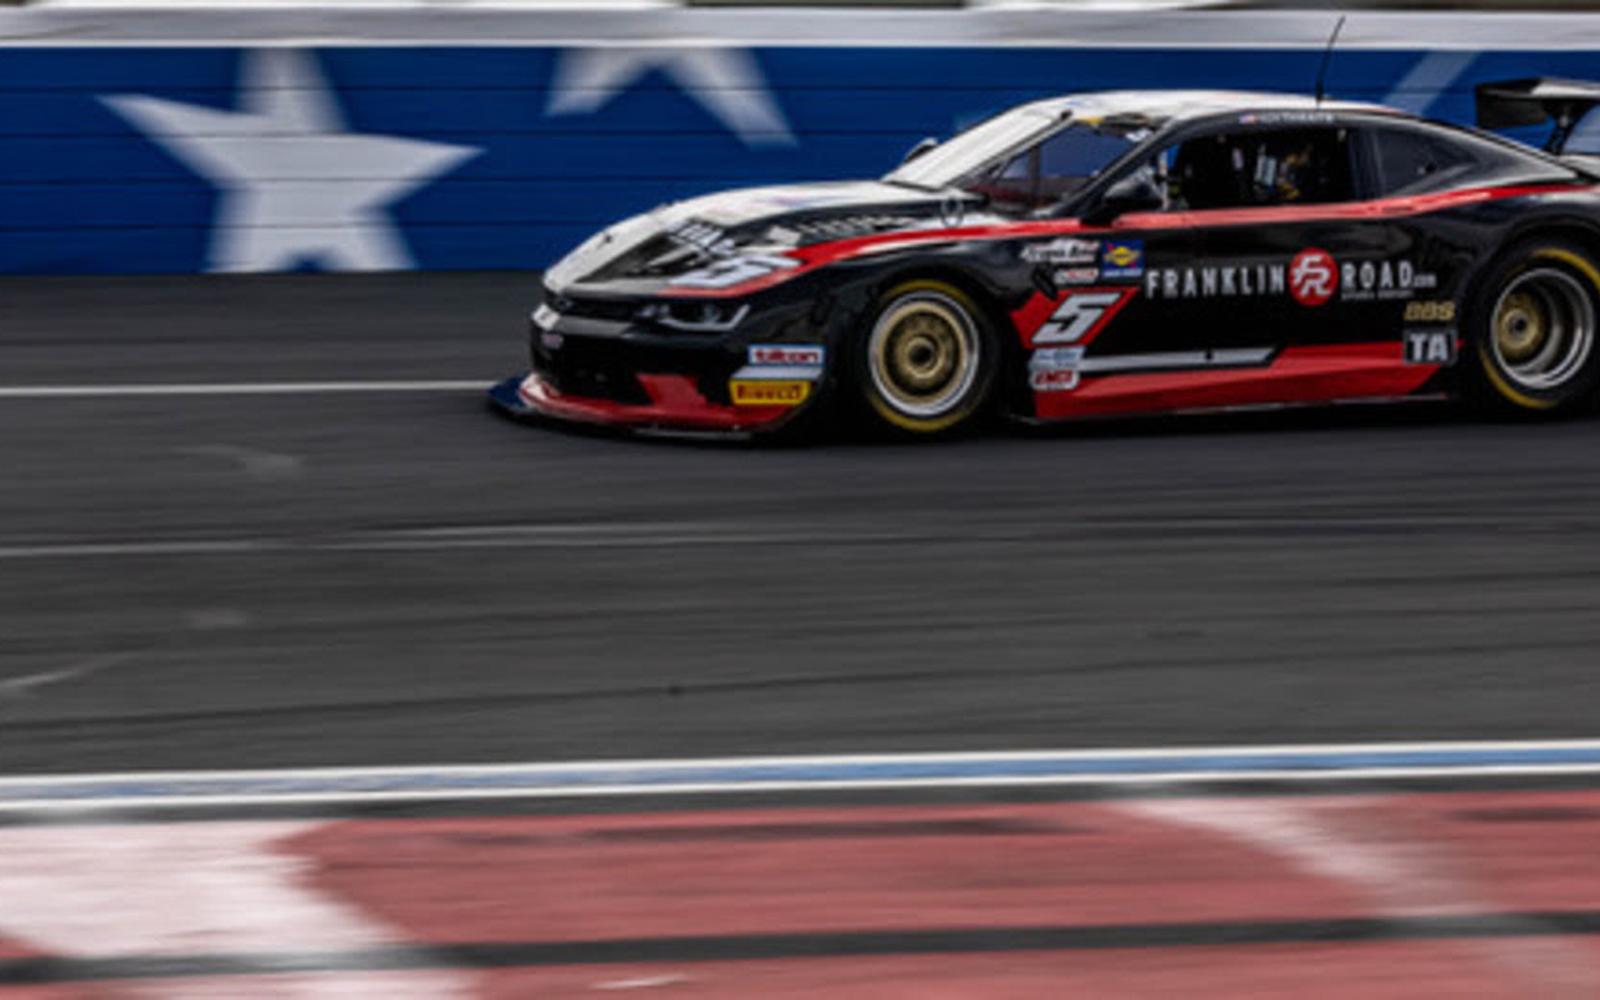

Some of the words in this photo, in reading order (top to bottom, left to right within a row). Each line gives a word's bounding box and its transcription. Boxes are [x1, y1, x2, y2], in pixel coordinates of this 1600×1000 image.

[1145, 264, 1286, 299] FRANKLIN
[1031, 293, 1121, 343] 5
[1403, 301, 1457, 321] BBS
[1409, 332, 1449, 361] TA
